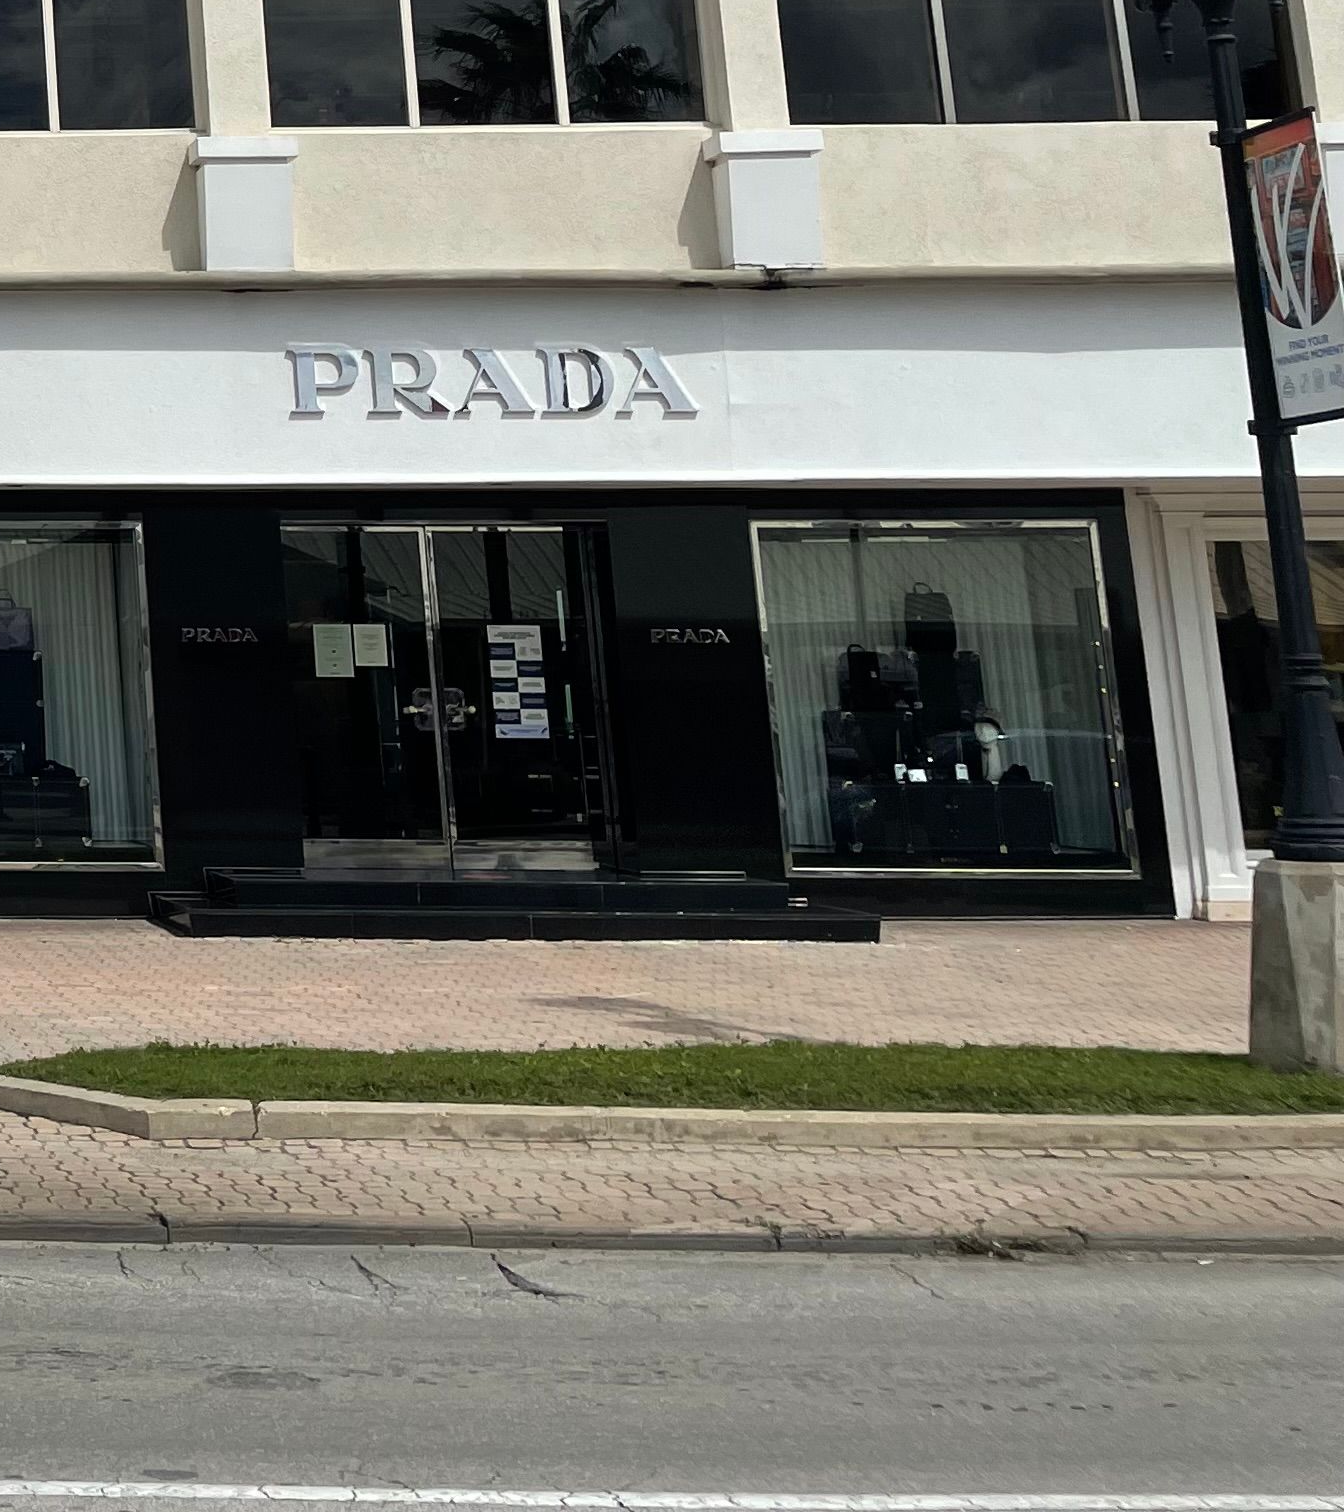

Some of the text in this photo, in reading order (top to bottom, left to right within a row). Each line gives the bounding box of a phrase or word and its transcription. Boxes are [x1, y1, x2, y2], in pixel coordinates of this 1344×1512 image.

[284, 342, 702, 420] PRADA
[180, 626, 260, 643] PRADA
[649, 628, 731, 644] PRADA
